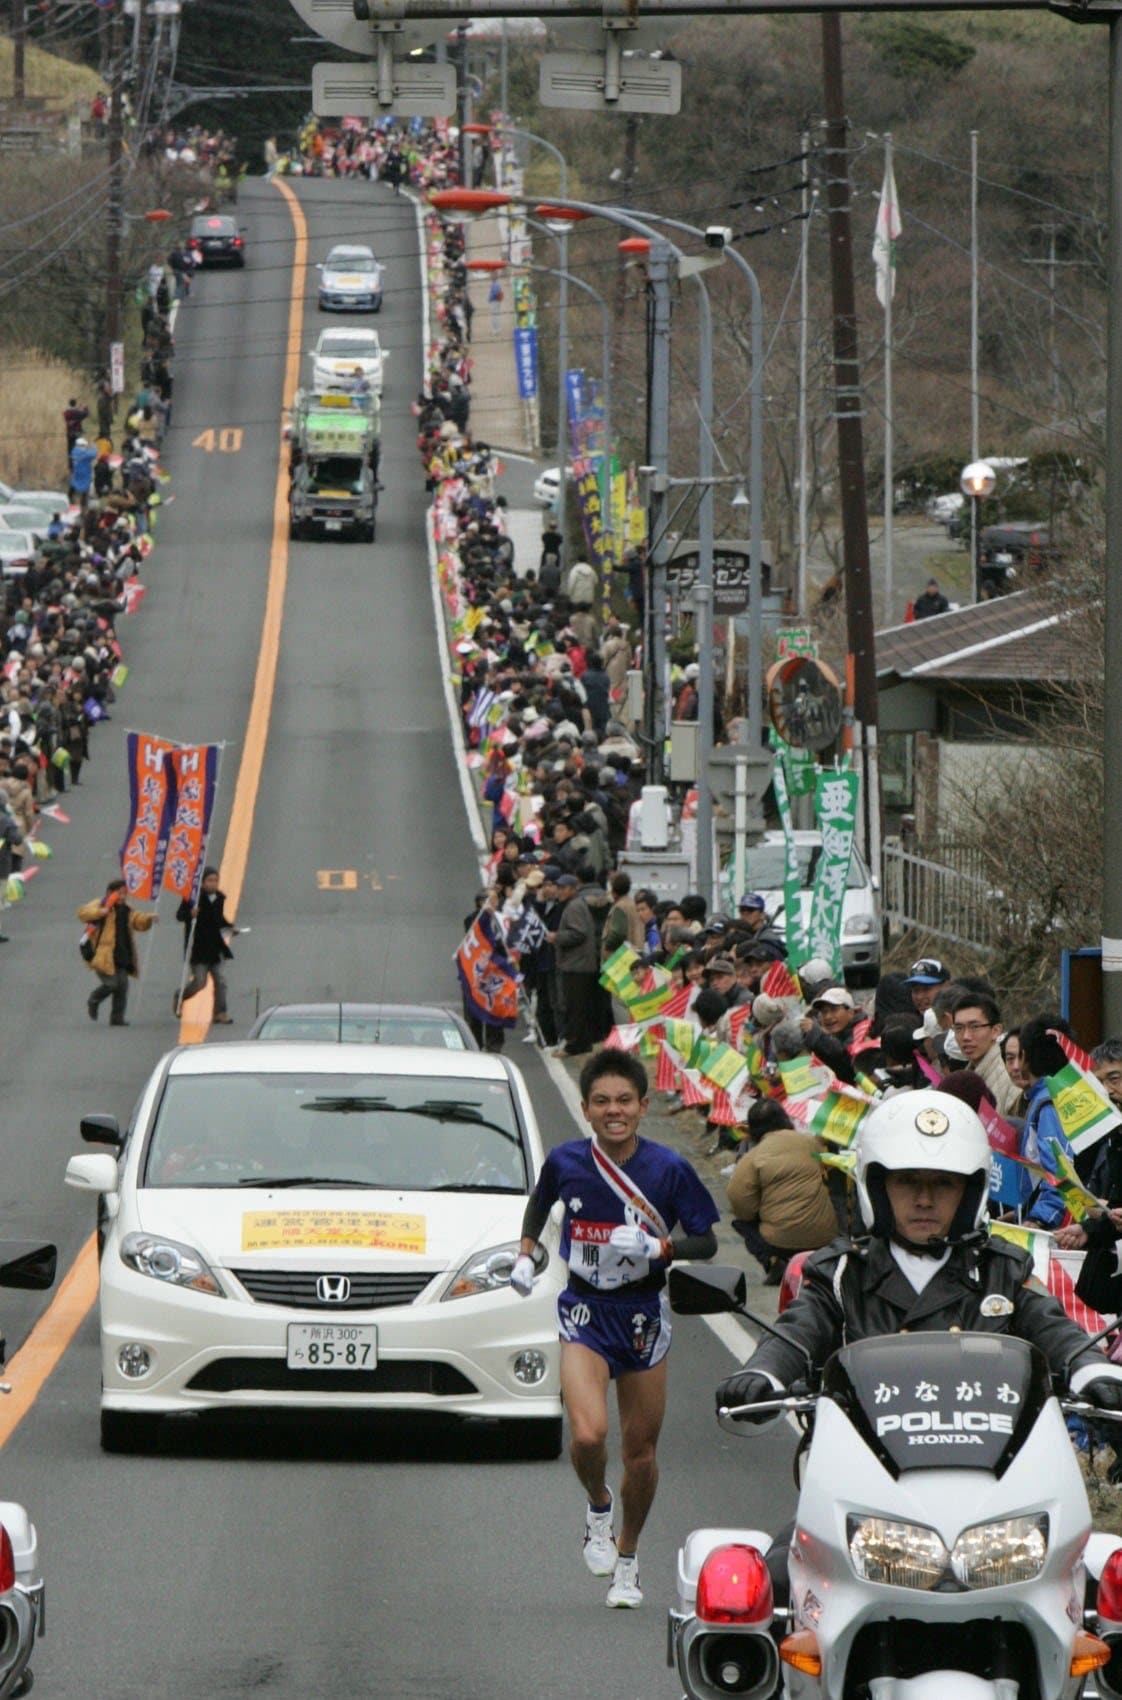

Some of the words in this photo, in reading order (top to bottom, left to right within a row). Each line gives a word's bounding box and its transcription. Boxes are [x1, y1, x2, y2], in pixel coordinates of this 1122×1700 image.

[191, 428, 243, 452] 40
[308, 1342, 371, 1365] 85-87
[874, 1380, 1021, 1405] かながわ
[876, 1410, 1015, 1438] POLICE
[907, 1433, 985, 1446] HONDA
